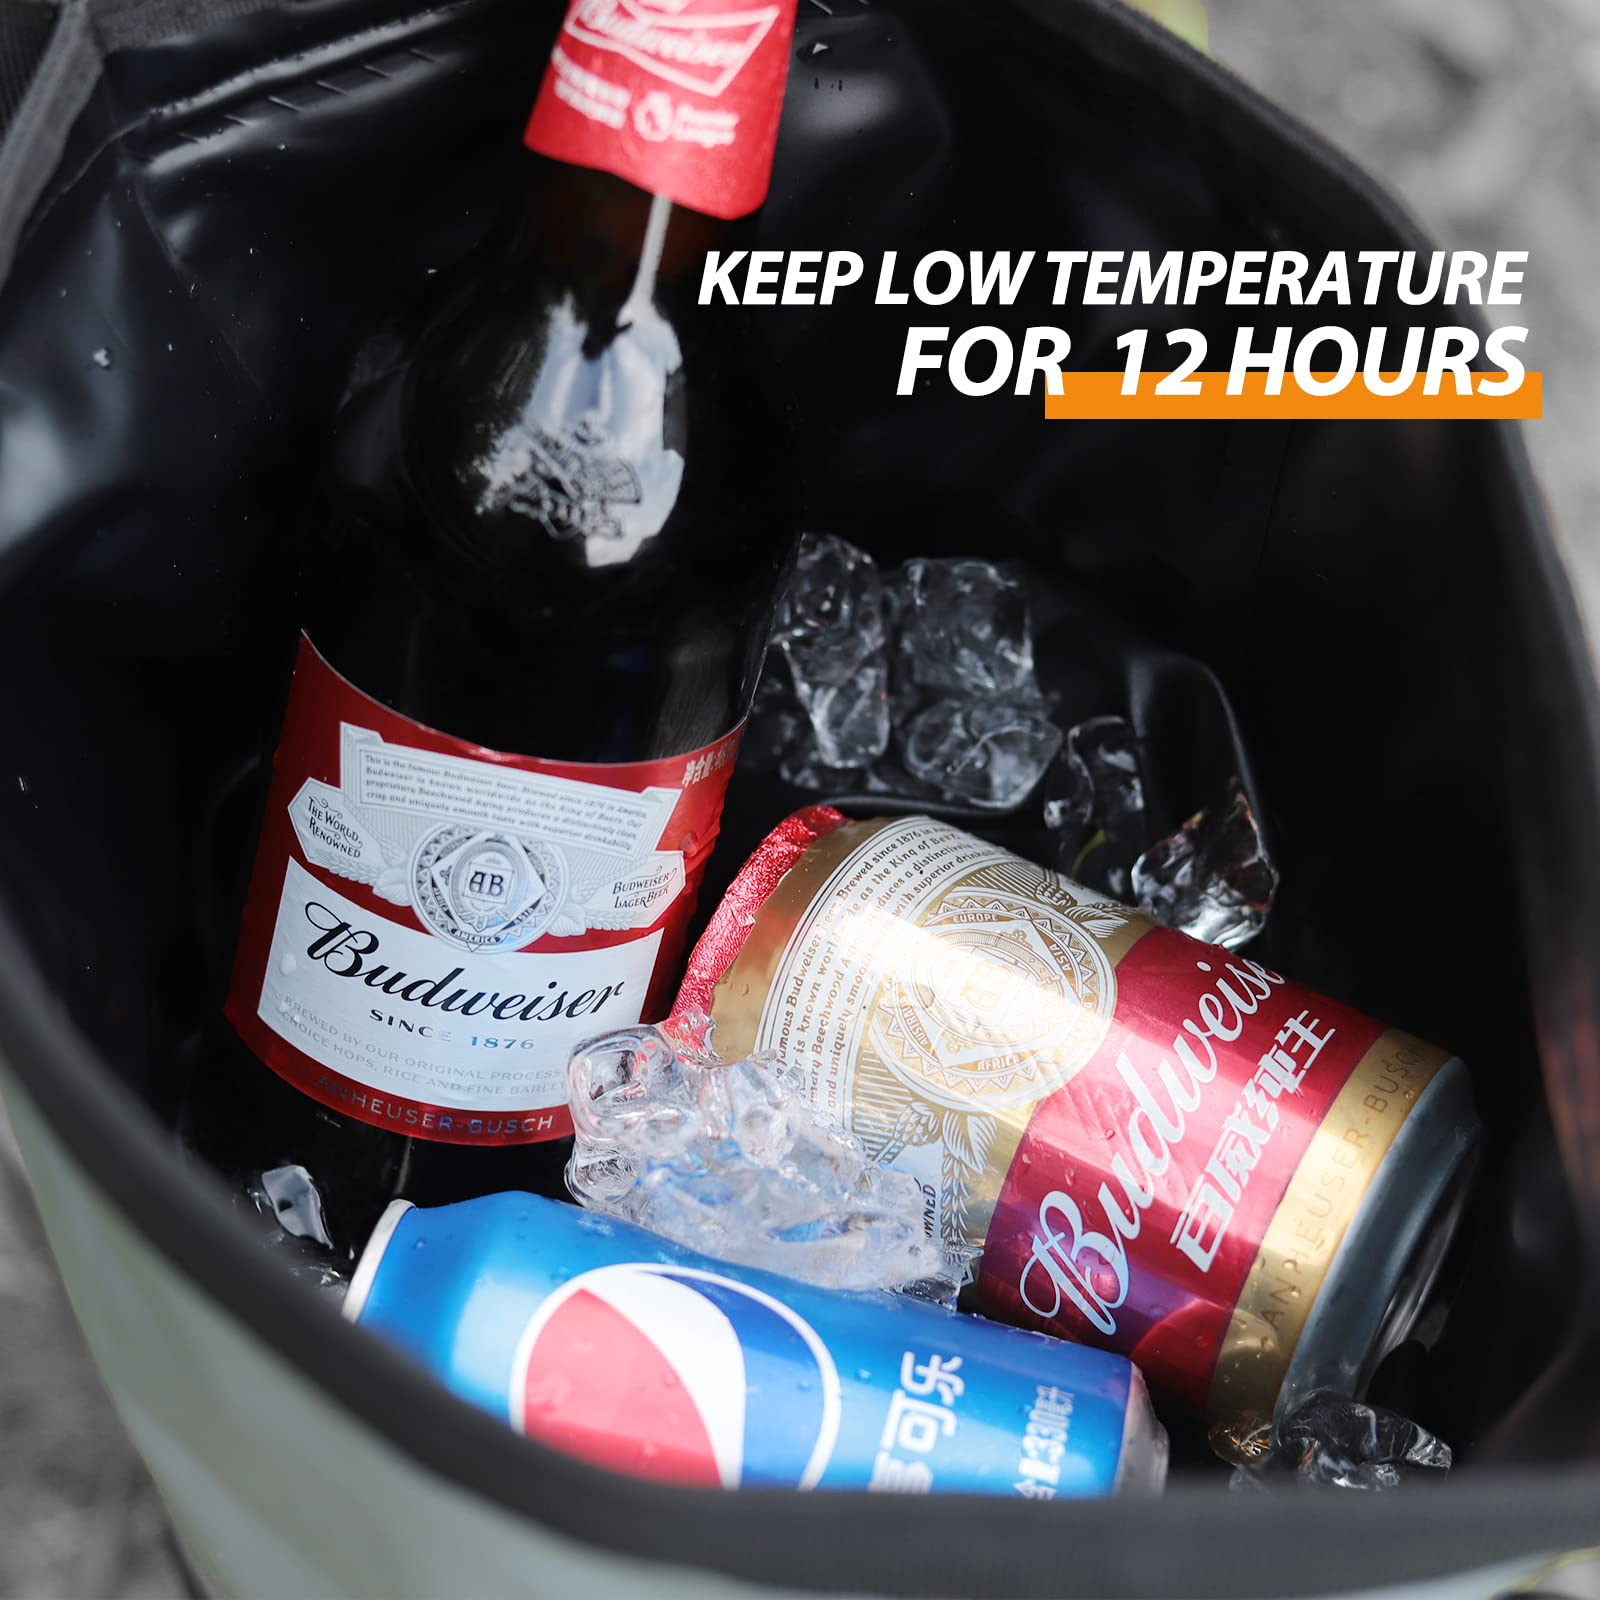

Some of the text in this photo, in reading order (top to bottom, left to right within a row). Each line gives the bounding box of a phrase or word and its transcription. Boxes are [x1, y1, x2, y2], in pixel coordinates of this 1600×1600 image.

[308, 795, 361, 844] THE WORLD
[309, 816, 361, 859] RENOWNED
[889, 847, 919, 869] King
[918, 840, 931, 852] of
[468, 870, 505, 897] AB
[612, 872, 670, 896] BUDWEISER
[860, 886, 875, 902] as
[872, 866, 892, 887] the
[614, 895, 650, 909] LAGER
[786, 932, 822, 1008] Budweiser
[836, 861, 874, 902] Brewed
[871, 842, 898, 864] since
[895, 831, 921, 847] 1876
[953, 913, 999, 924] EUROPE
[455, 928, 497, 944] AMERICA
[1049, 943, 1073, 971] ASIA
[303, 901, 625, 1022] Budweiser
[811, 969, 845, 1056] Beechwood
[906, 869, 914, 879] a
[830, 1008, 854, 1076] uniquely
[890, 891, 916, 919] with
[914, 862, 955, 894] superior
[797, 980, 822, 1033] known
[281, 1010, 329, 1048] CHOICE
[333, 1042, 378, 1072] HOPS,
[383, 1064, 422, 1083] RICE
[424, 1078, 462, 1091] AND
[285, 995, 562, 1082] BREWED BY OUR ORIGINAL PROCESS
[369, 1008, 535, 1051] SINCE 1876
[793, 1039, 806, 1054] is
[976, 1053, 1021, 1073] AFRICA
[314, 1074, 554, 1135] ANHEUSER-BUSCH
[1020, 959, 1286, 1336] Budweise
[1170, 1009, 1337, 1273] 百威纯生
